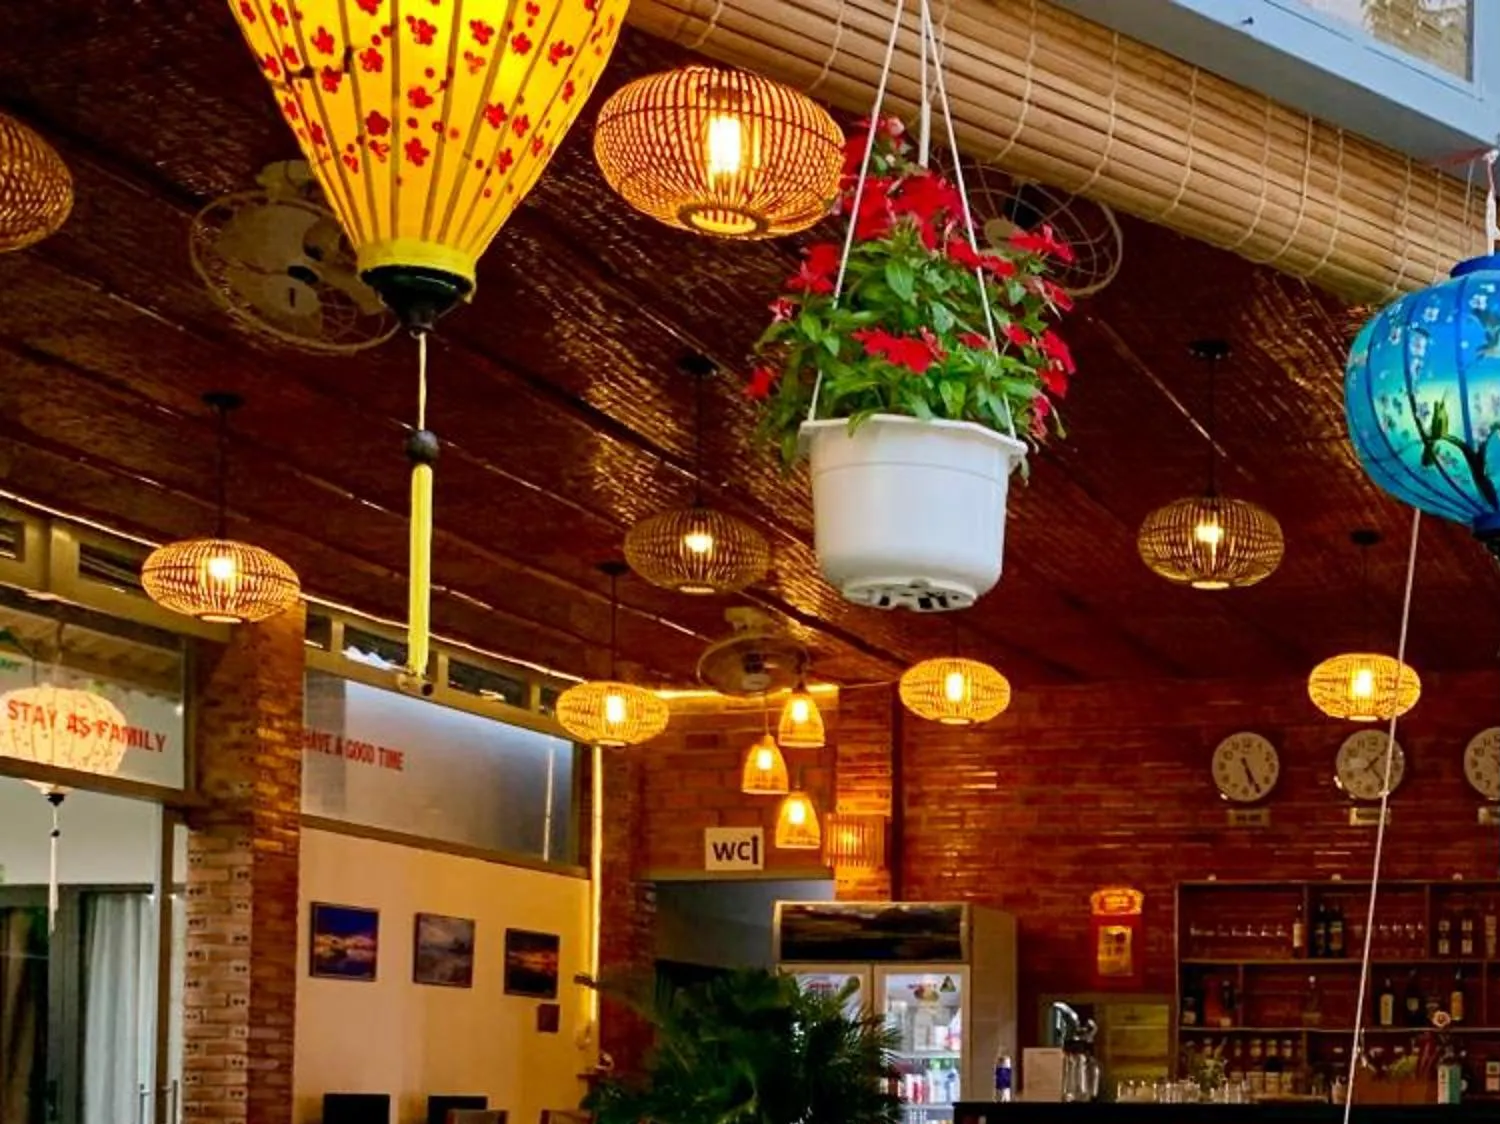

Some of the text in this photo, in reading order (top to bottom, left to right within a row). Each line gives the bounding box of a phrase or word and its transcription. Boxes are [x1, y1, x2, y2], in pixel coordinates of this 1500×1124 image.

[7, 700, 166, 753] STAY AS FAMILY
[345, 739, 375, 764] GOOD
[378, 746, 403, 771] TIME
[712, 841, 751, 862] WC
